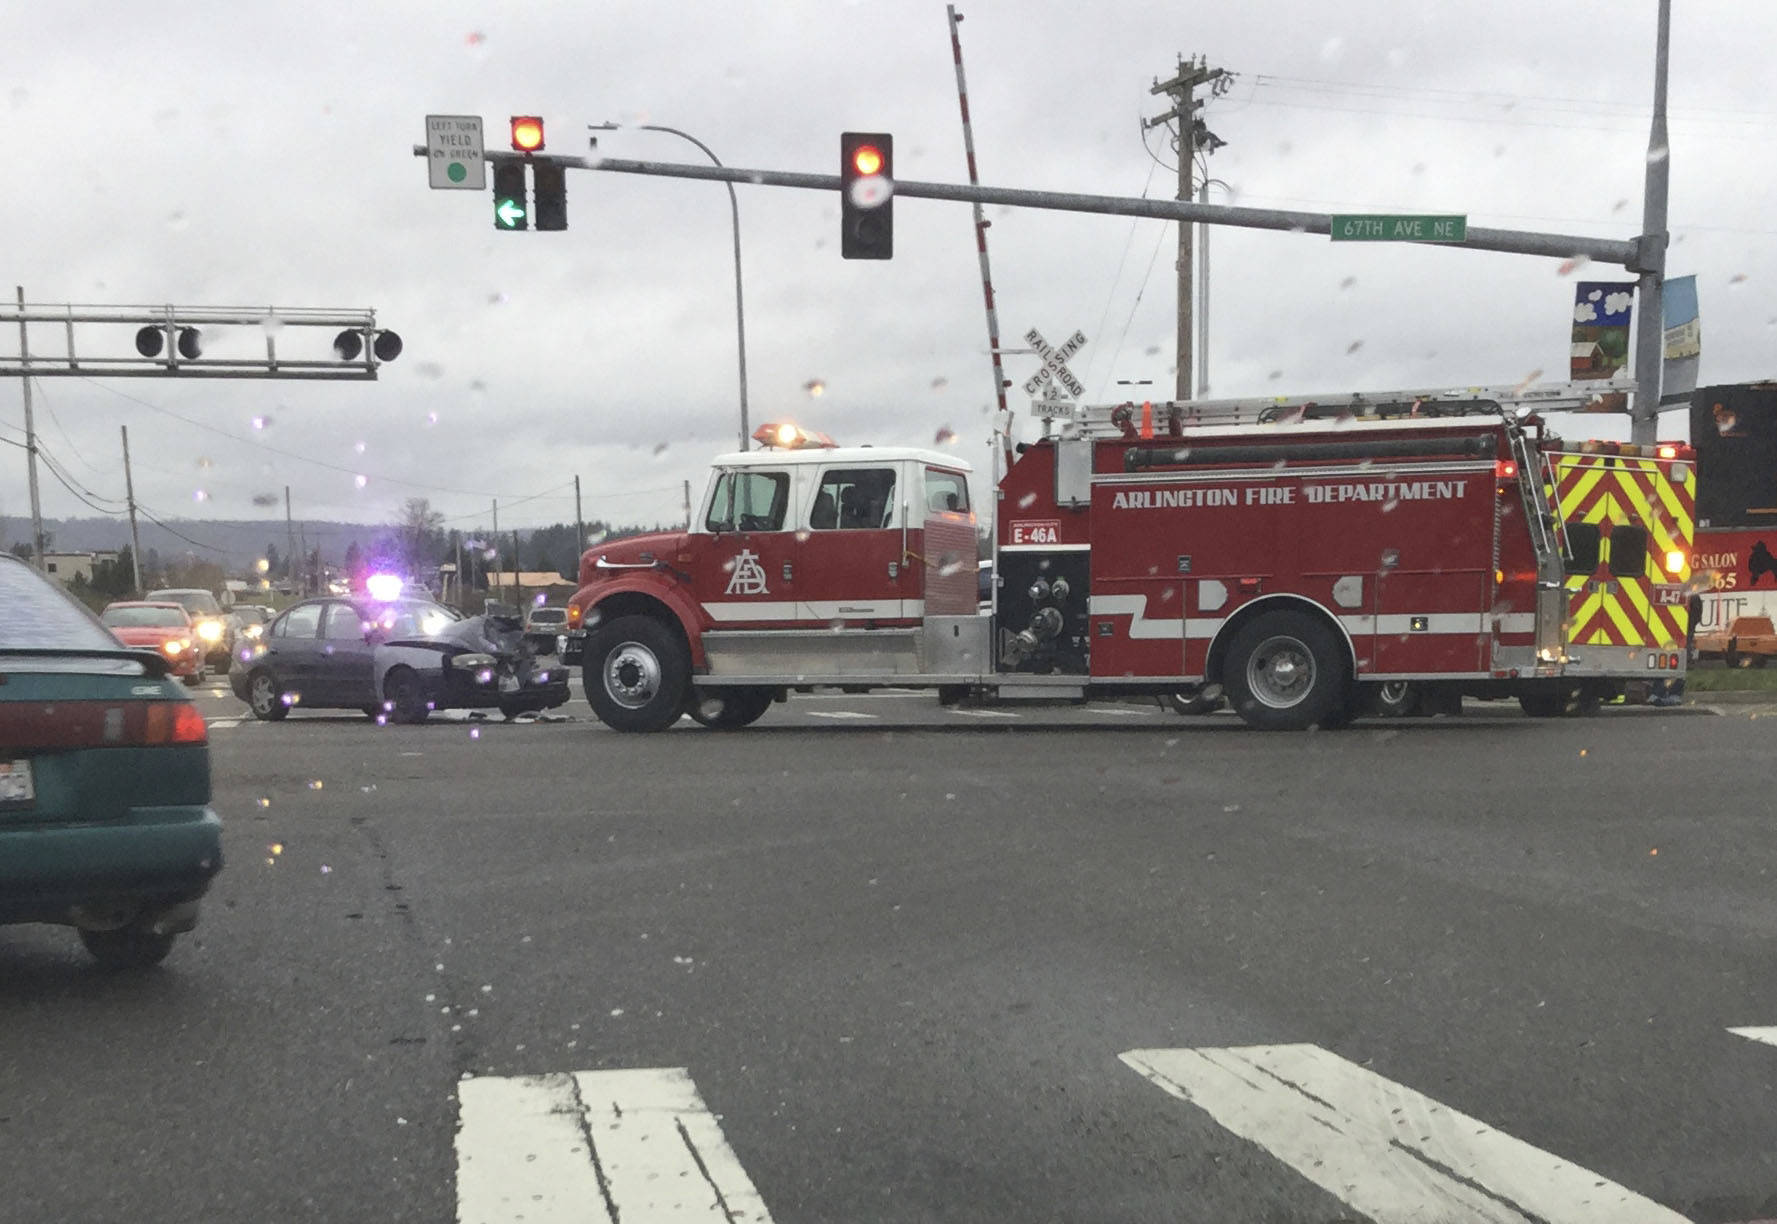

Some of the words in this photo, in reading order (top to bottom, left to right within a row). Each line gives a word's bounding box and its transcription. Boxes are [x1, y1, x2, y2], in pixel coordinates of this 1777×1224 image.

[431, 121, 452, 130] LEFT
[440, 134, 472, 146] YIELD
[1344, 220, 1383, 236] 67TH
[1394, 221, 1423, 236] AVE
[1433, 222, 1454, 237] NE
[1049, 390, 1058, 401] 2
[1038, 404, 1071, 416] TRACKS
[1112, 488, 1237, 509] ARLINGTON
[1245, 487, 1296, 505] FIRE
[1306, 480, 1468, 503] DEPARTMENT
[1014, 527, 1057, 543] E-46A
[1701, 552, 1738, 568] SALON
